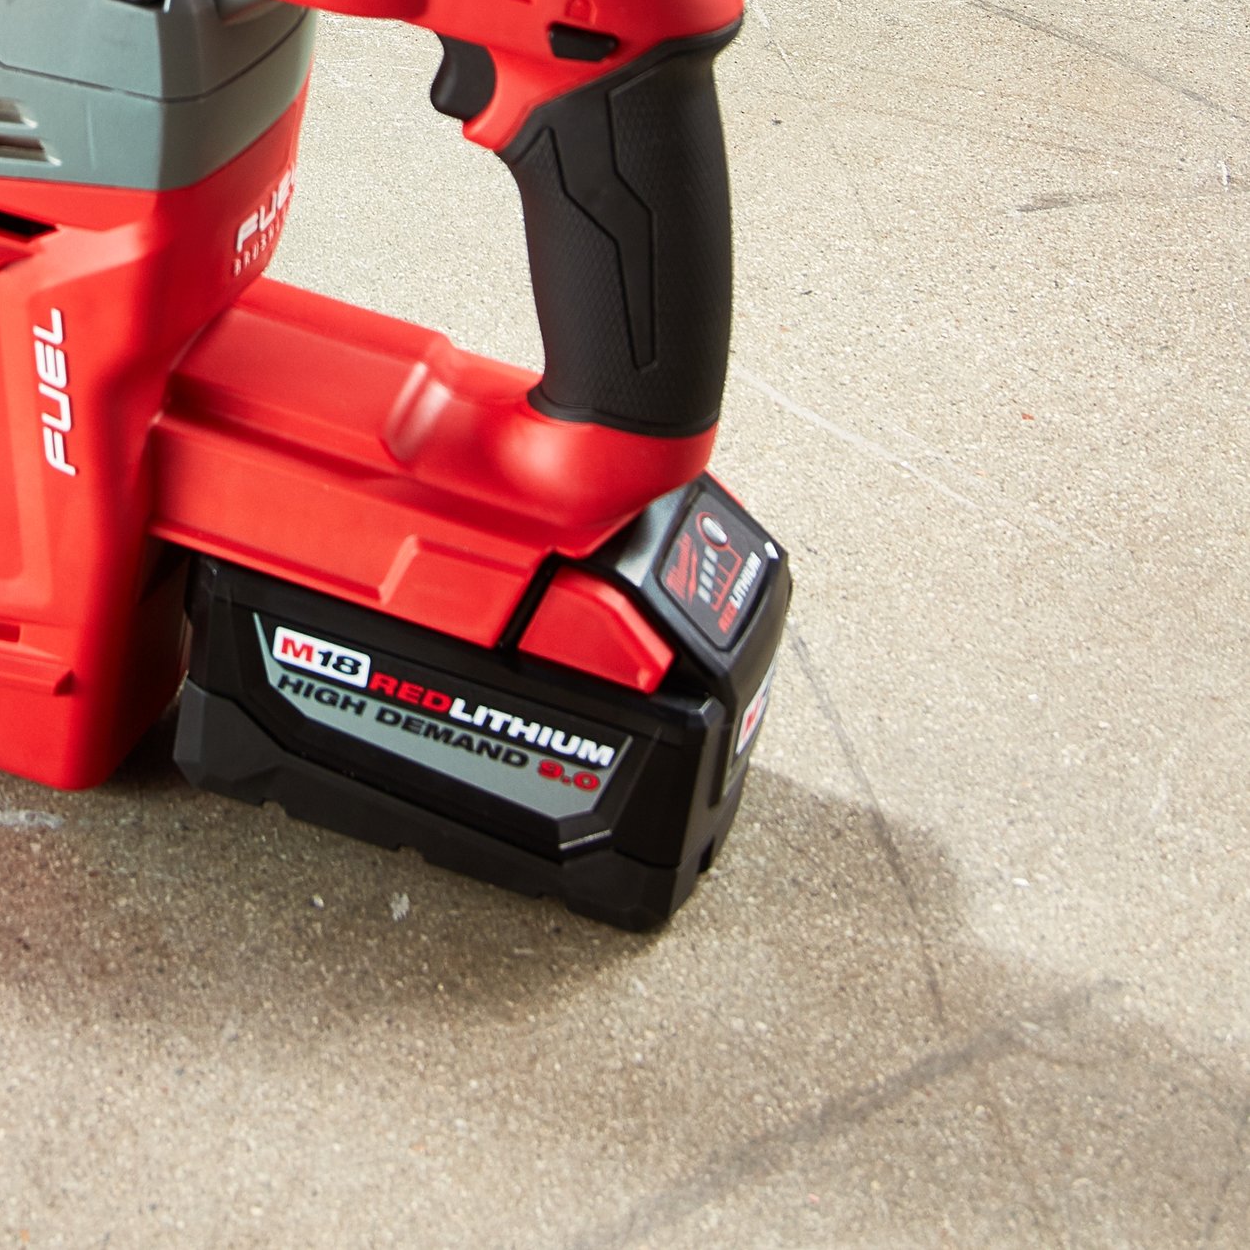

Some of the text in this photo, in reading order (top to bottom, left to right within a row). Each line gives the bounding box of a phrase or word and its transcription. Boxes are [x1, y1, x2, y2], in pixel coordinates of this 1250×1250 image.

[33, 307, 77, 476] FUEL
[277, 673, 601, 792] HIGH DEMAND 9.0
[280, 635, 616, 768] M18 REDLITHIUM
